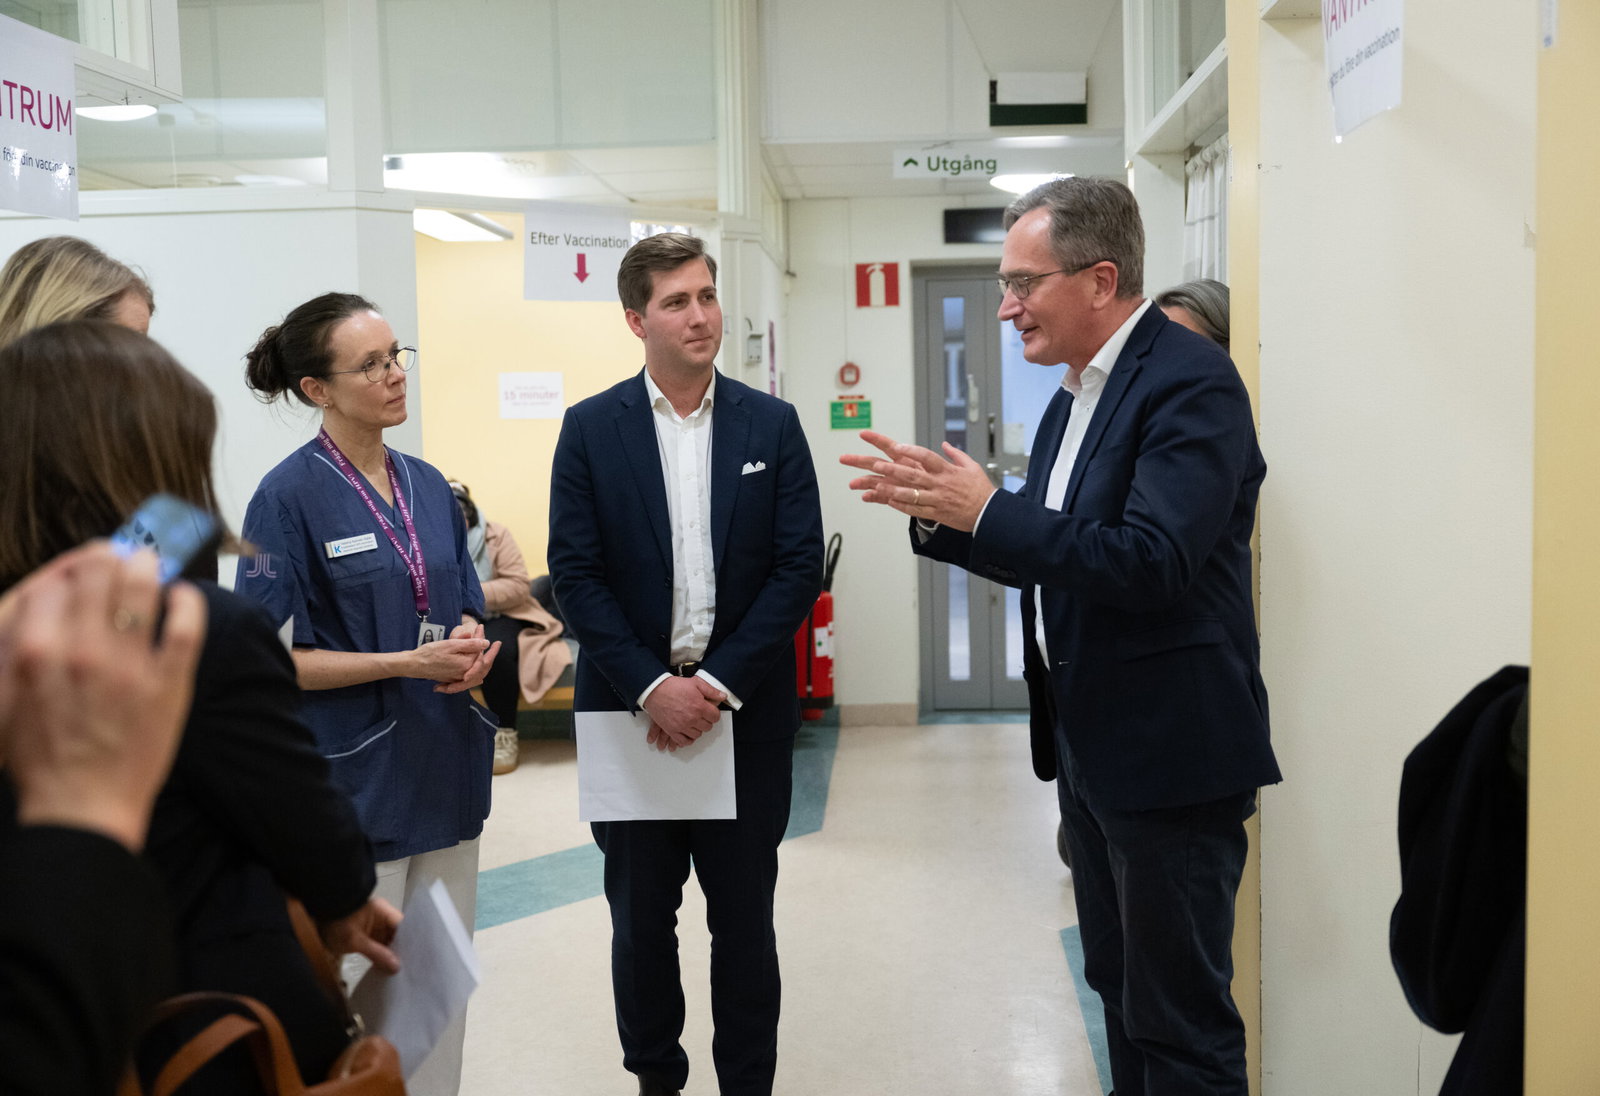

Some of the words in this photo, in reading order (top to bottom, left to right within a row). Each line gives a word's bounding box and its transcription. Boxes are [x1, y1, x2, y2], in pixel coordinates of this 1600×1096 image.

[1364, 27, 1400, 59] vaccination
[0, 79, 72, 136] TRUM
[927, 154, 997, 175] Utgång
[530, 231, 560, 246] Efter
[564, 233, 629, 249] Vaccination
[504, 390, 516, 400] 15
[520, 390, 559, 400] minuter
[334, 545, 342, 554] K
